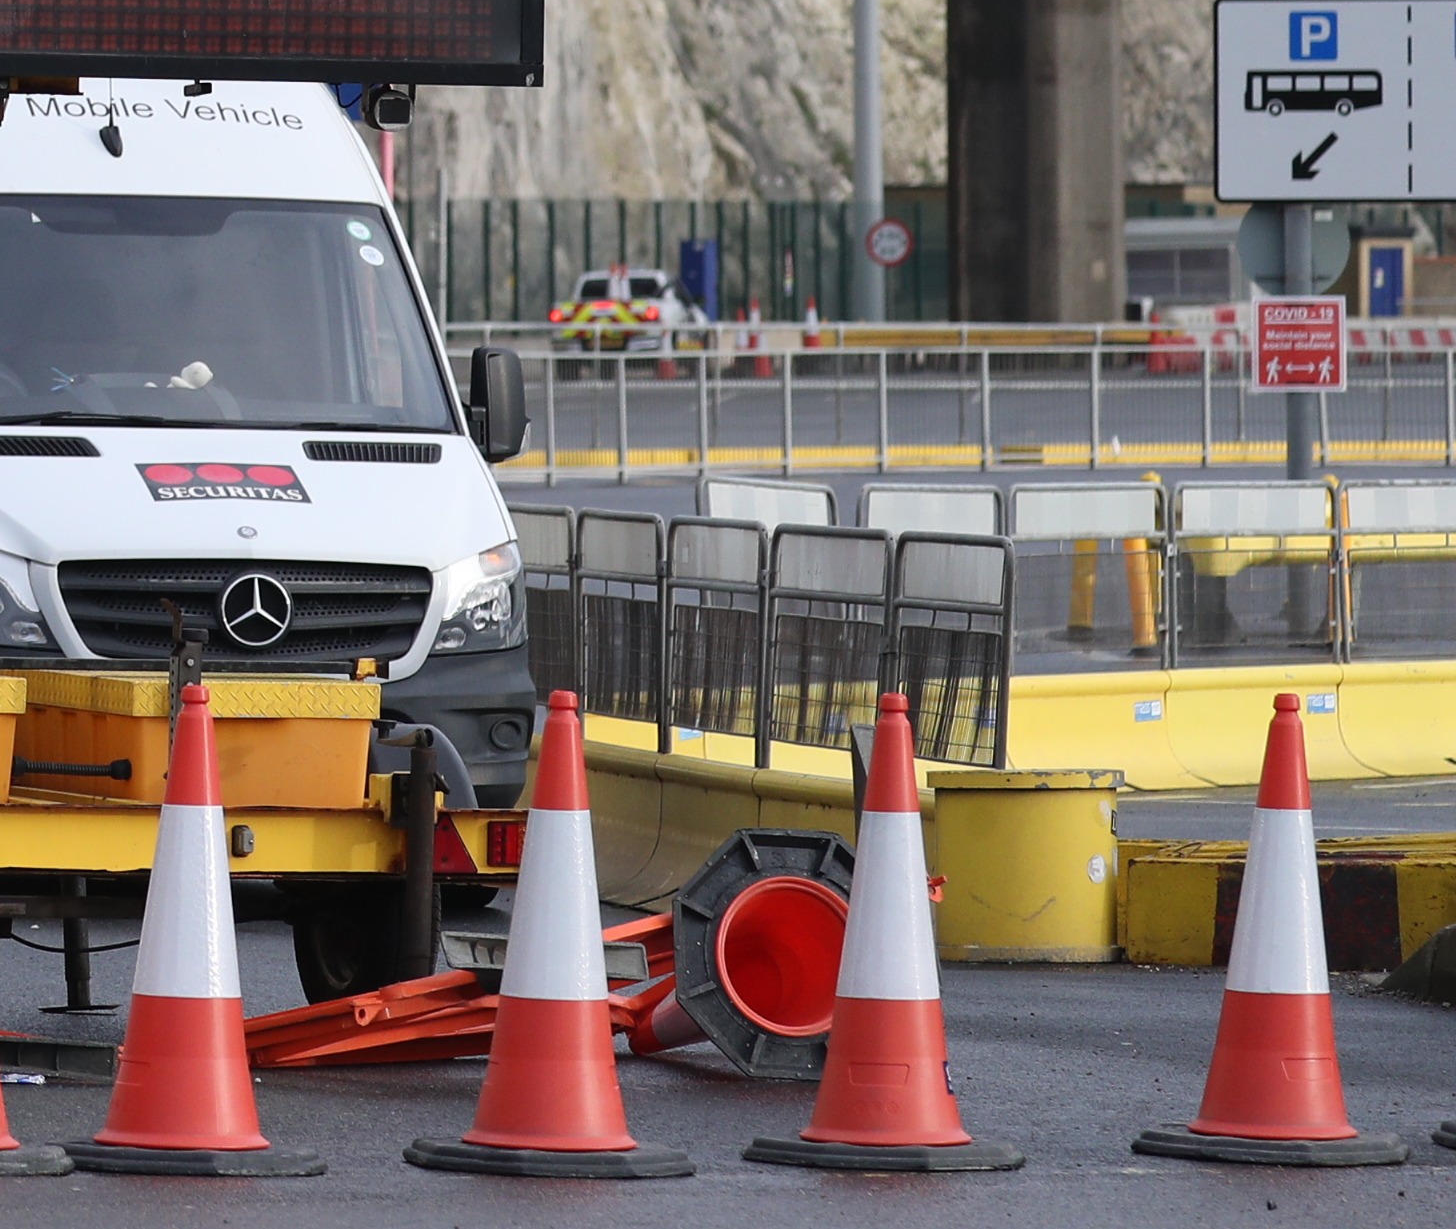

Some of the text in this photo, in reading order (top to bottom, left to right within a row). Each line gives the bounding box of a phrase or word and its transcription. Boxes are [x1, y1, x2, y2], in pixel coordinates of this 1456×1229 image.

[1300, 15, 1332, 58] P
[25, 96, 305, 131] Mobile Vehicle
[1264, 306, 1308, 321] COVID
[1319, 306, 1334, 321] 19
[1265, 330, 1308, 341] Maintain
[157, 486, 304, 502] SECURITAS
